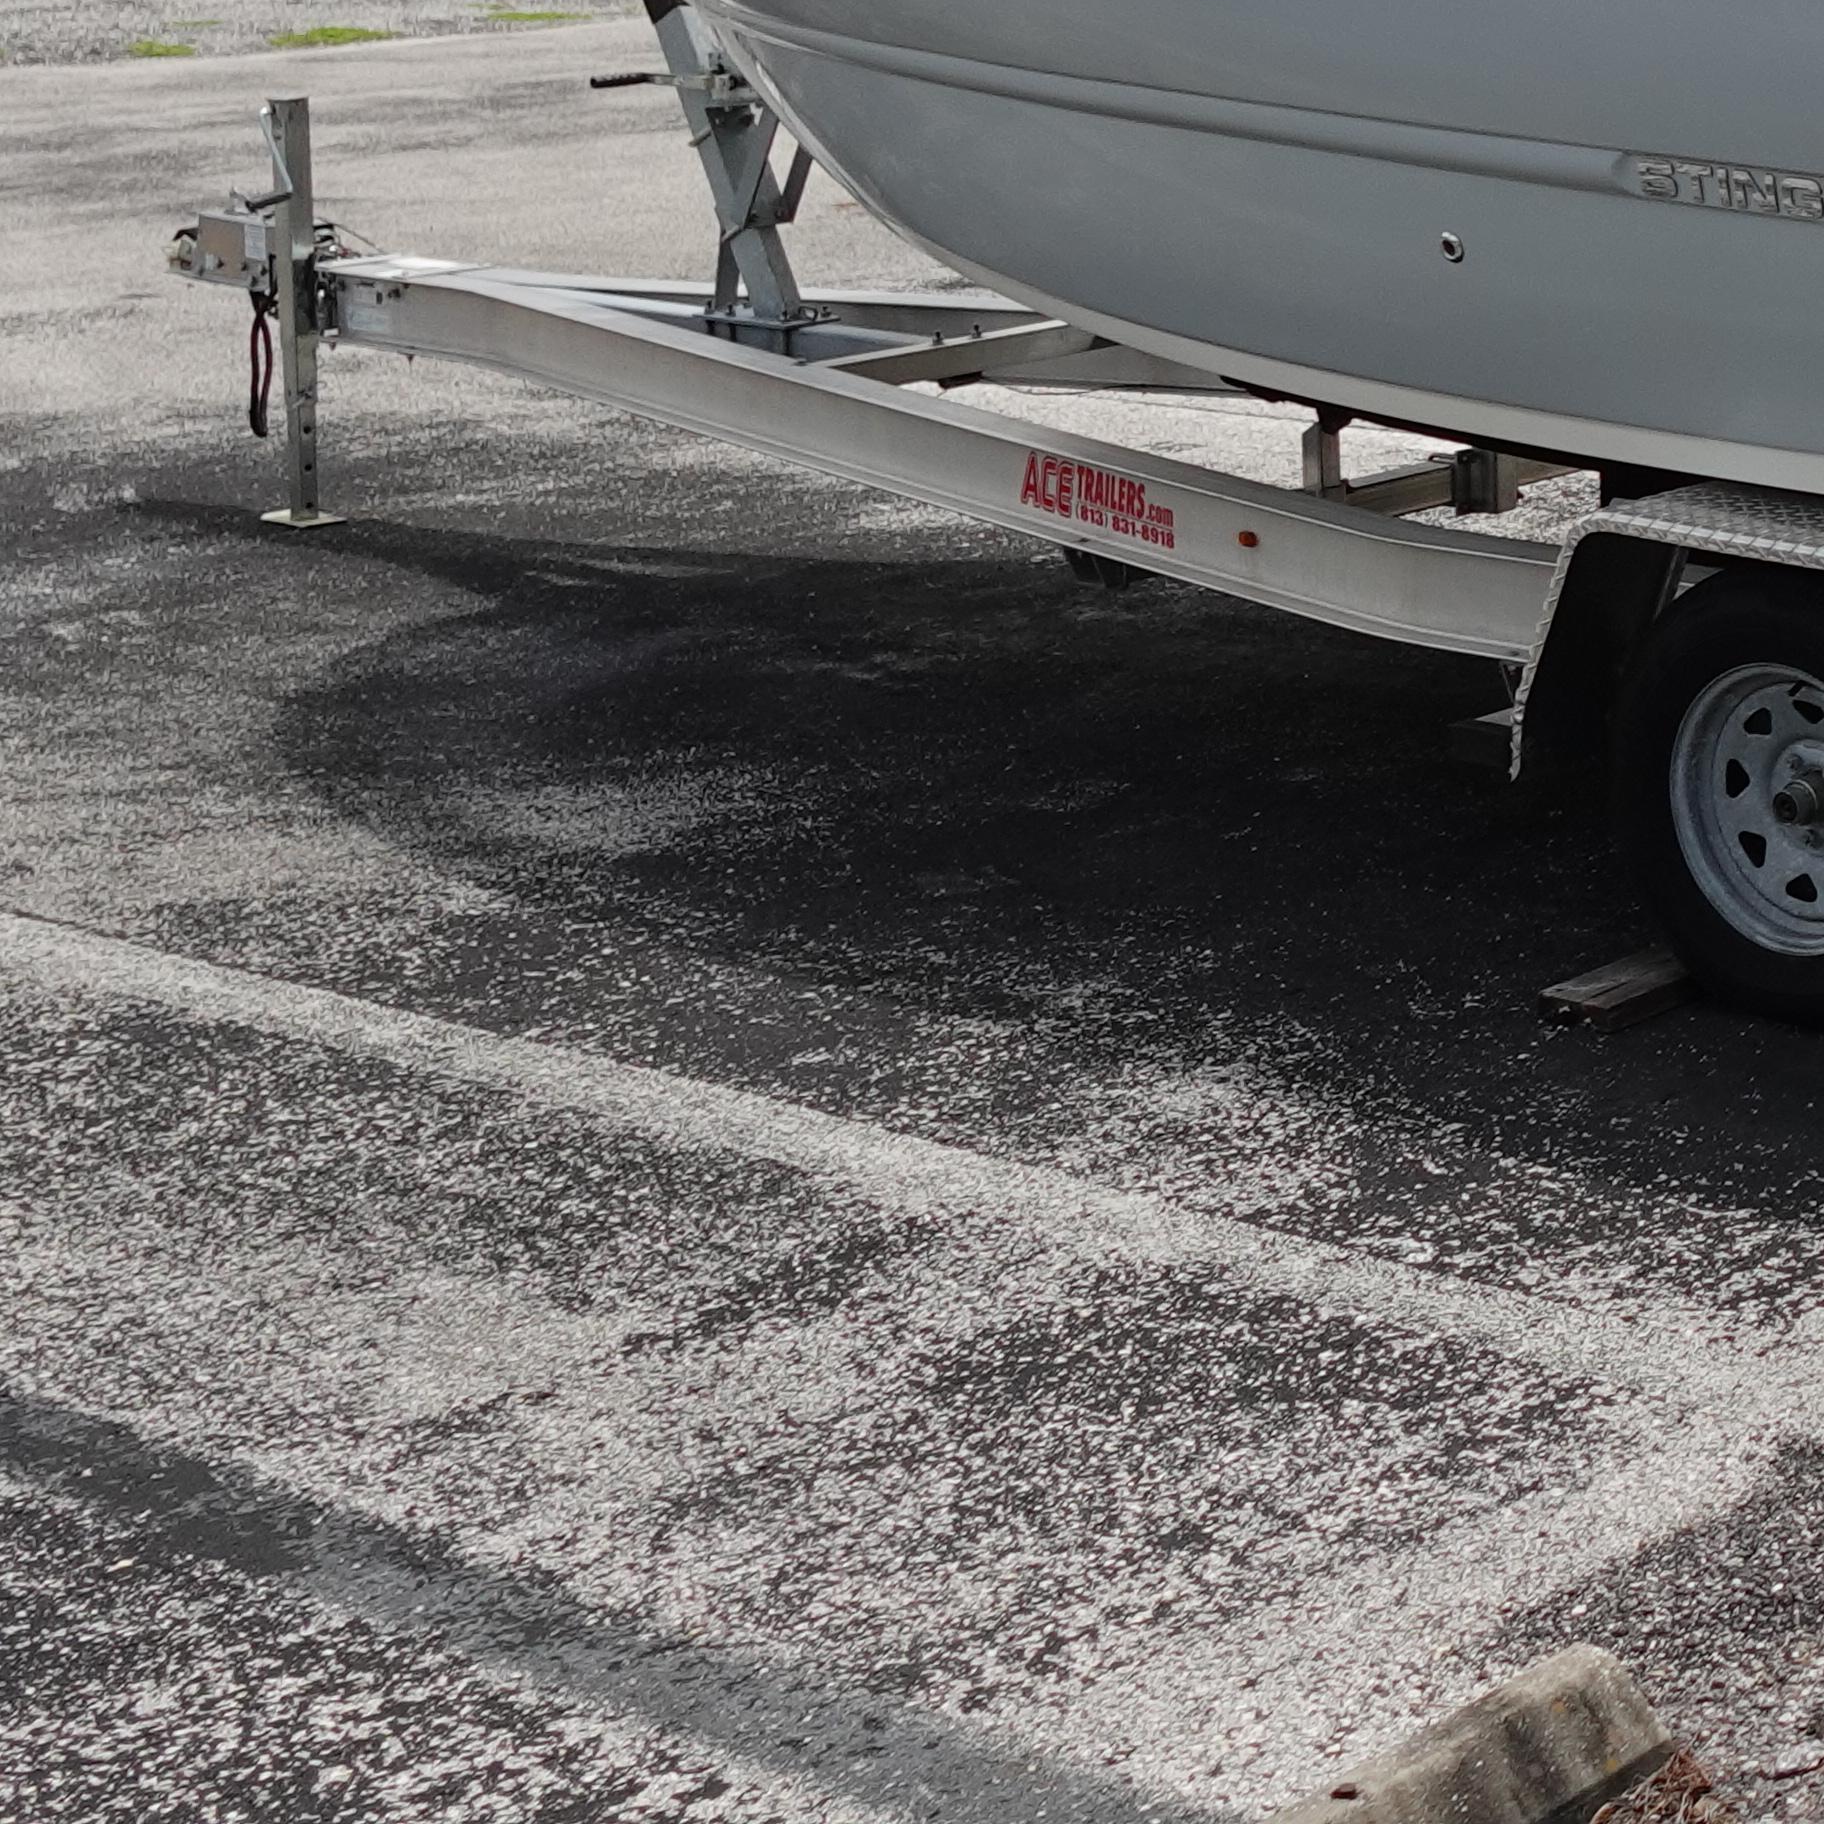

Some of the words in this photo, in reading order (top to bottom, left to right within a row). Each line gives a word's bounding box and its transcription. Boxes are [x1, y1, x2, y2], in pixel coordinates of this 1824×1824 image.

[1020, 450, 1075, 519] ACE
[1075, 501, 1109, 528] (813)
[1112, 514, 1175, 549] 831-8918
